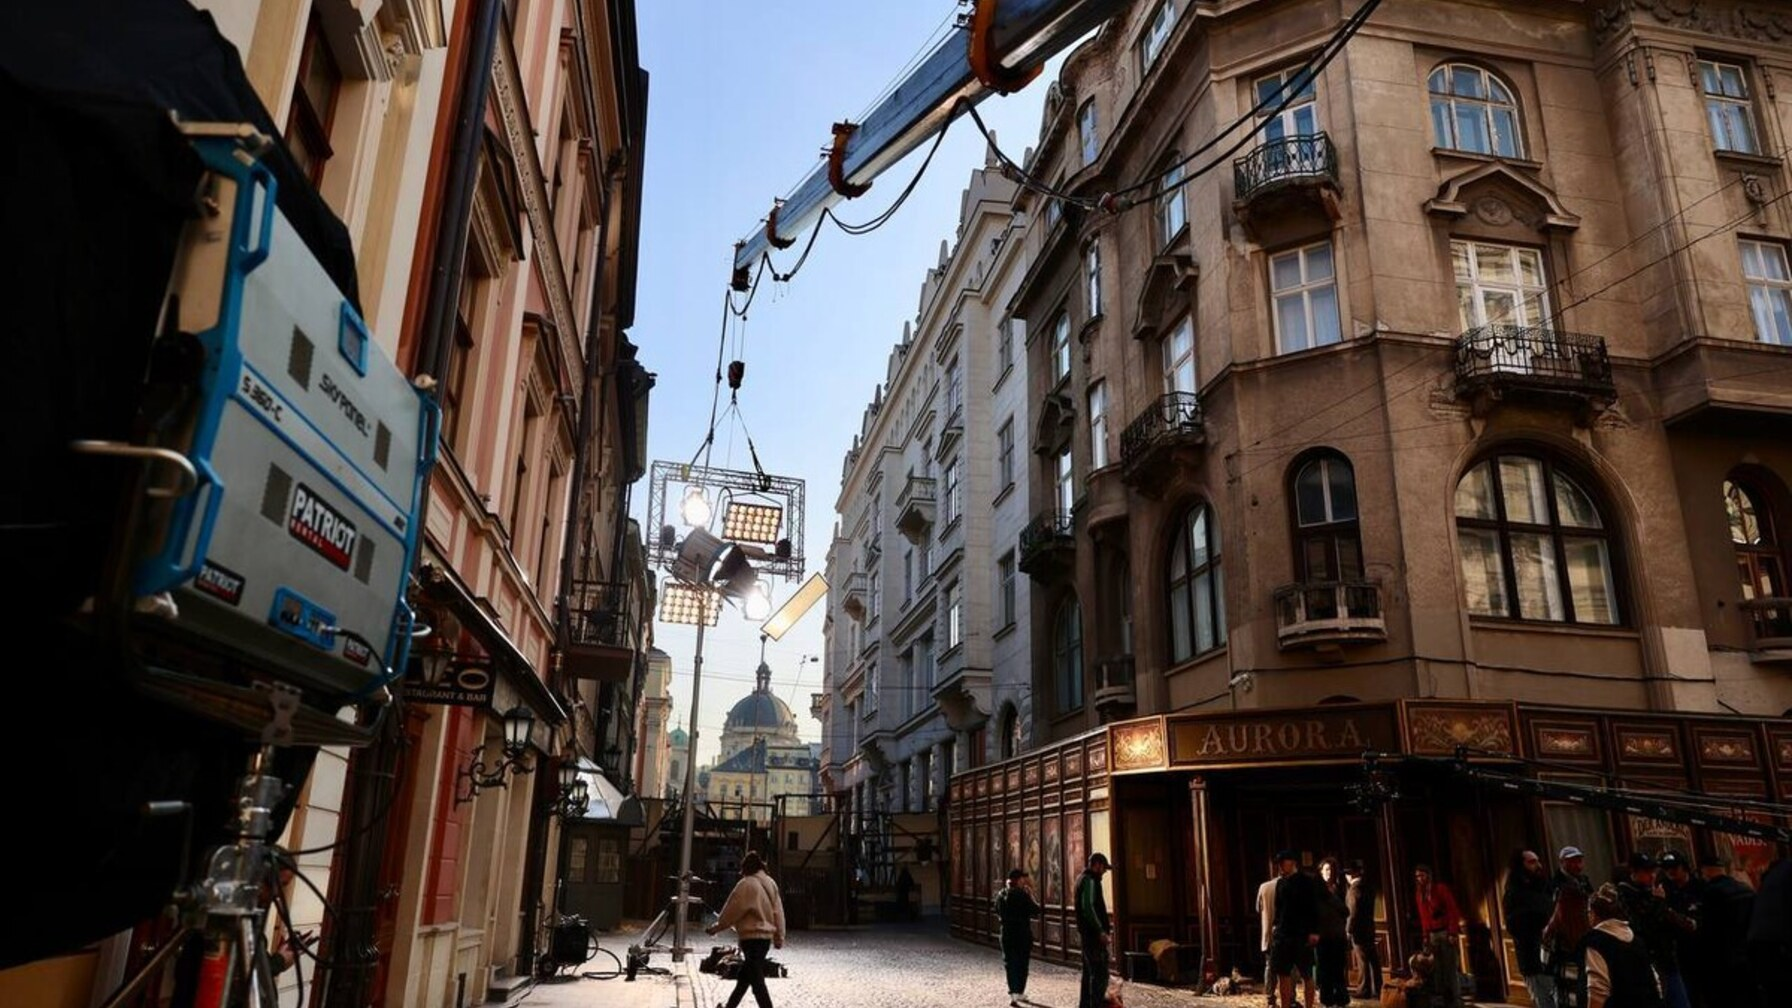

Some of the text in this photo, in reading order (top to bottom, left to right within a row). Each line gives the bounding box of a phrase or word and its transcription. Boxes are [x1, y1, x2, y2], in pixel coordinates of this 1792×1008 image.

[292, 487, 356, 556] PATRIOT
[466, 693, 487, 702] BAR
[1196, 719, 1364, 755] AURORA
